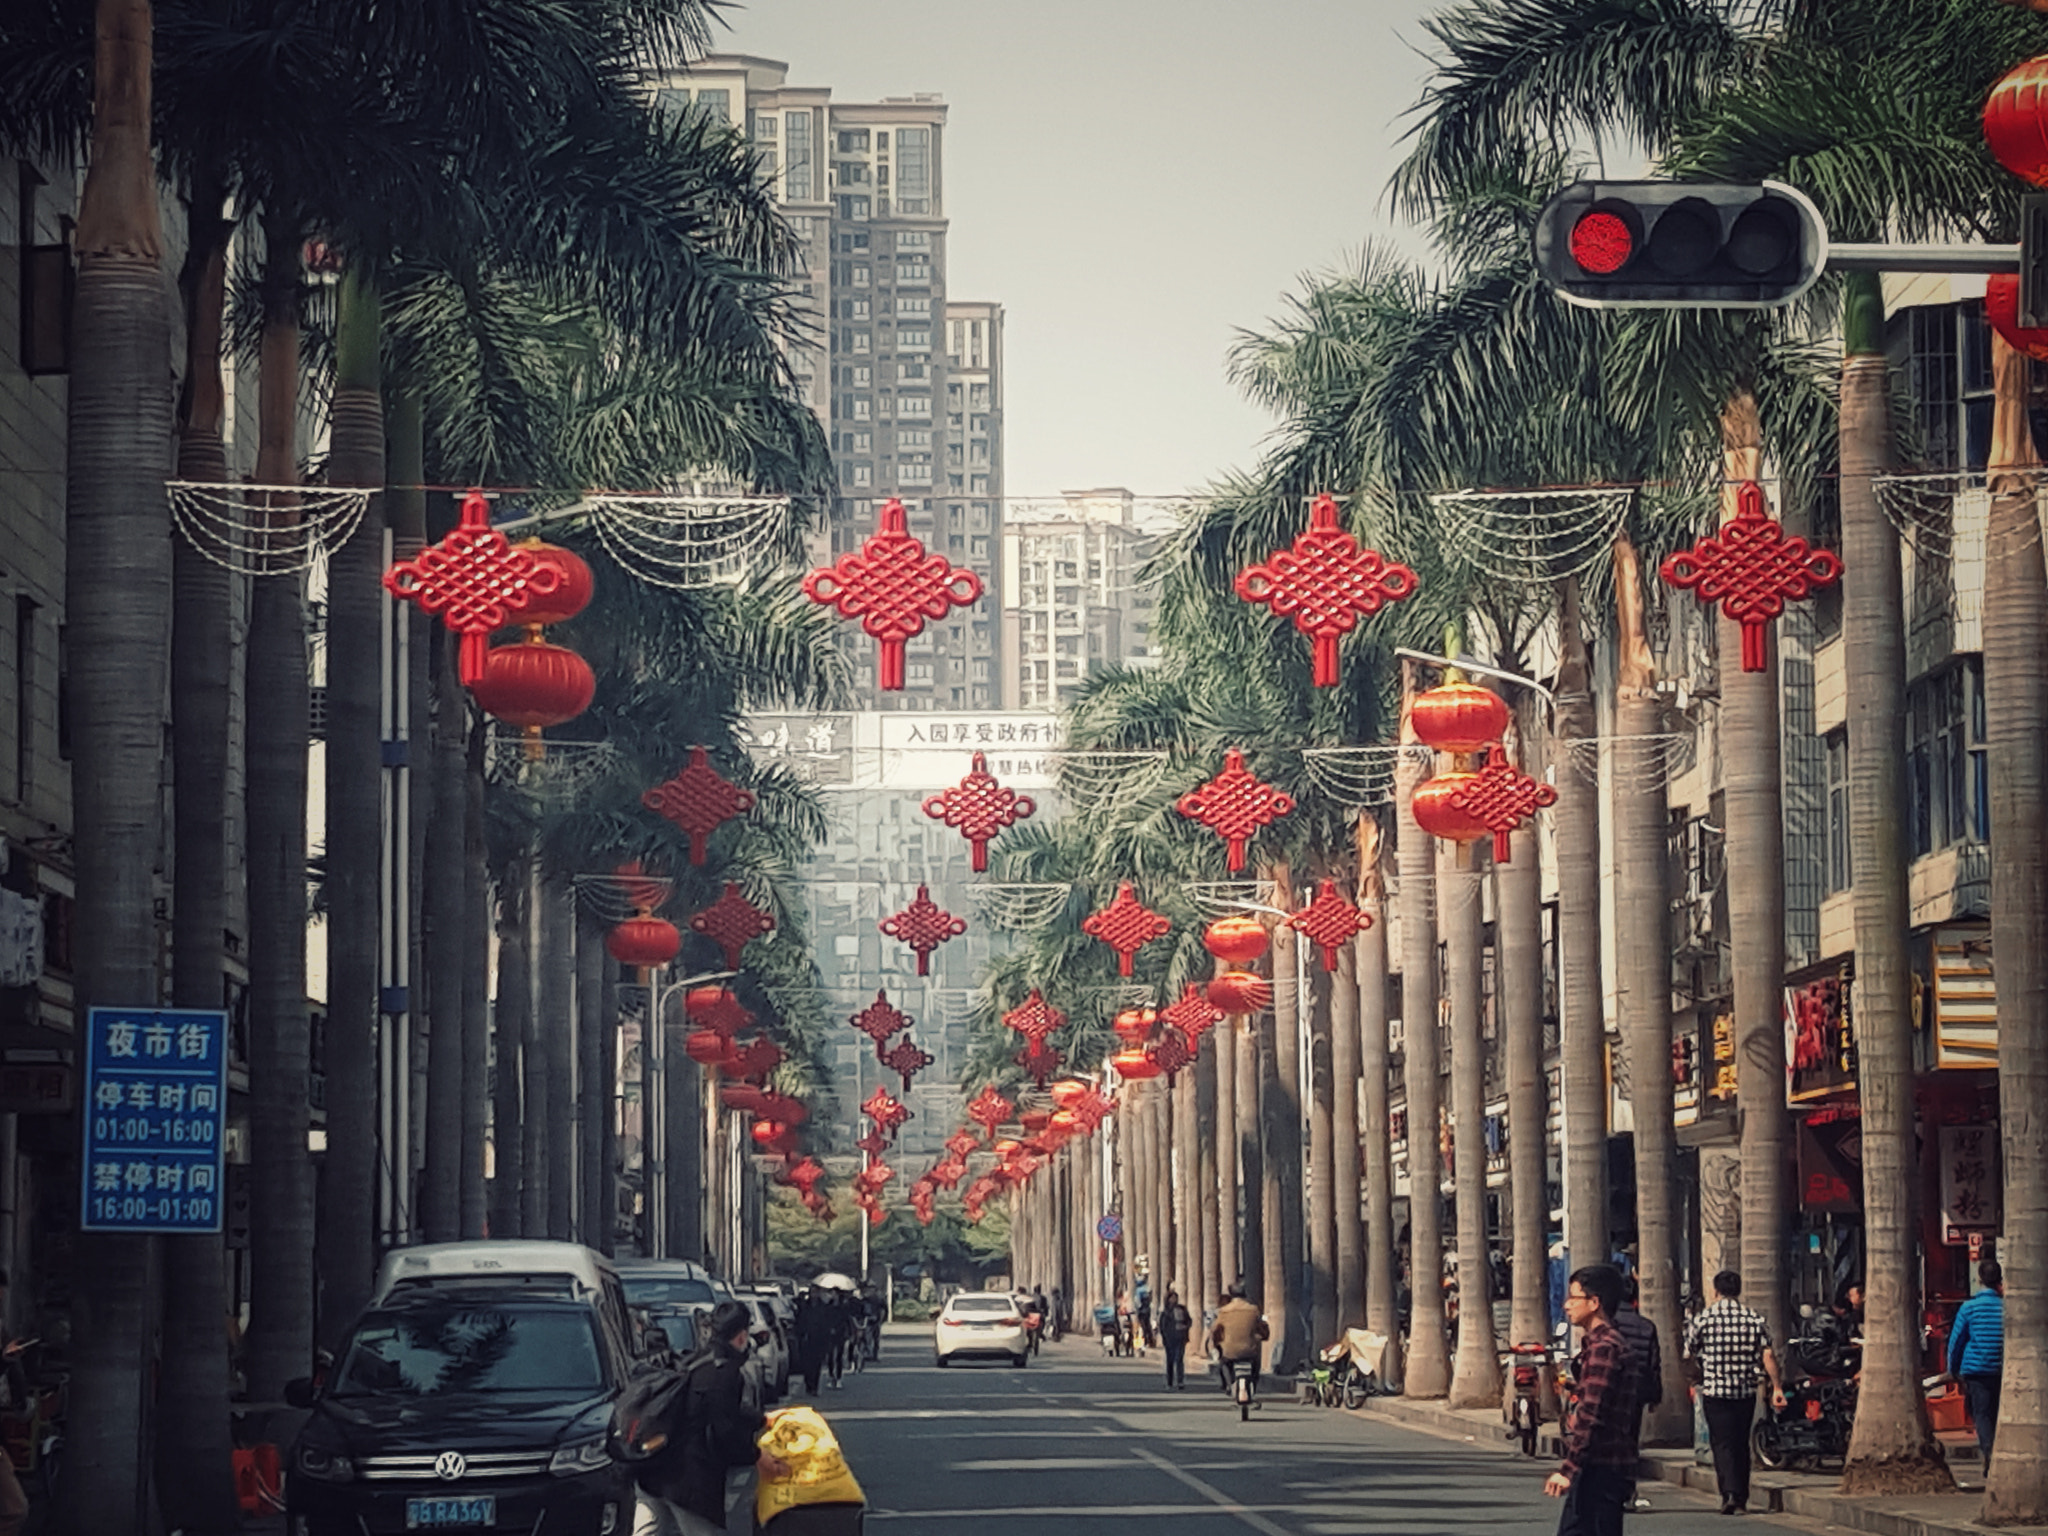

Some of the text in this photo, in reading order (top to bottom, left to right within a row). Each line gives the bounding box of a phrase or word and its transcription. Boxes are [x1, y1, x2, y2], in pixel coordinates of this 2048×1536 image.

[107, 1020, 211, 1060] 夜市街
[96, 1081, 217, 1112] 停车时间
[95, 1117, 215, 1142] 01:00-16:00
[94, 1162, 216, 1192] 禁停时间
[94, 1196, 212, 1221] 16:00-01:00
